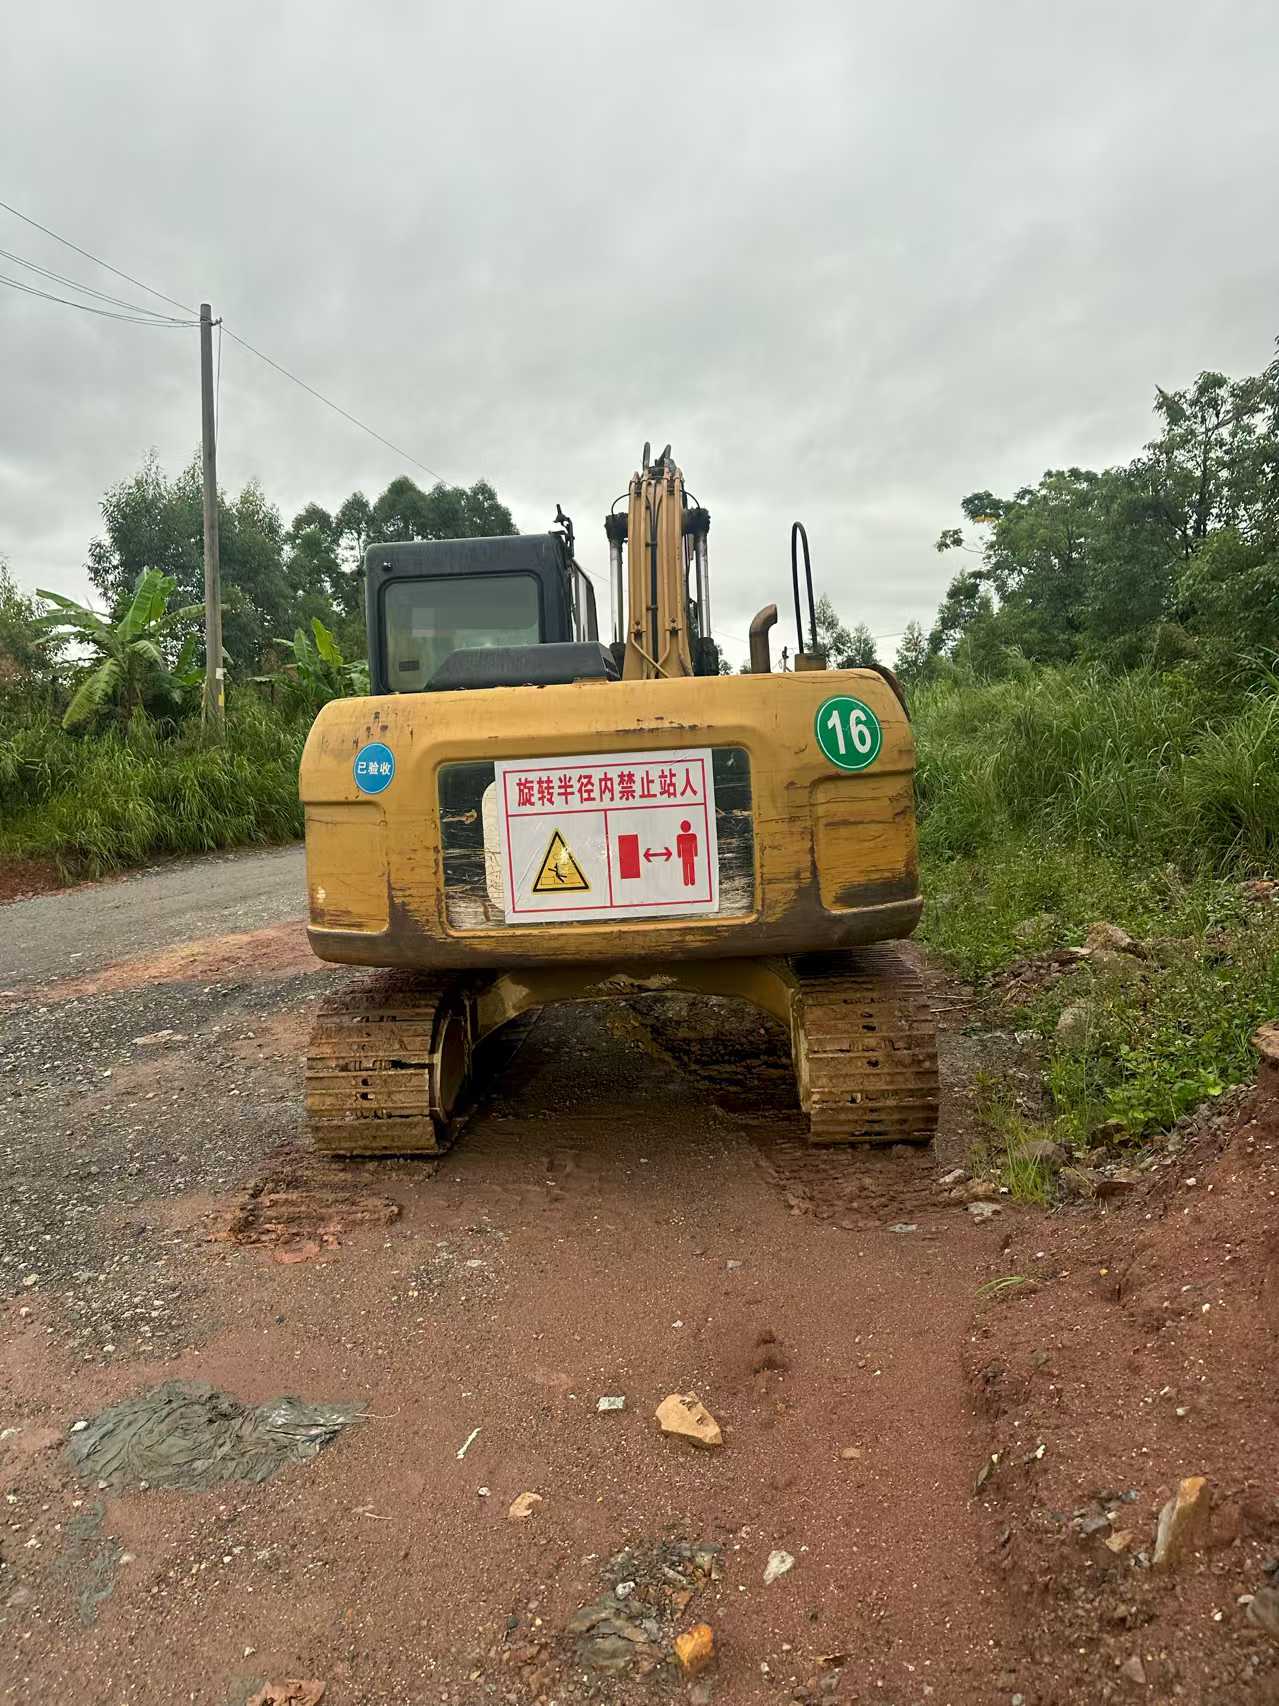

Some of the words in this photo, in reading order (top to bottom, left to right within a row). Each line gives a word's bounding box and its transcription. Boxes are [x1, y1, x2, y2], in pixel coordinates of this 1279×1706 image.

[827, 708, 872, 755] 16
[357, 761, 391, 775] 已验收
[516, 767, 698, 807] 旋转半径内禁止站人
